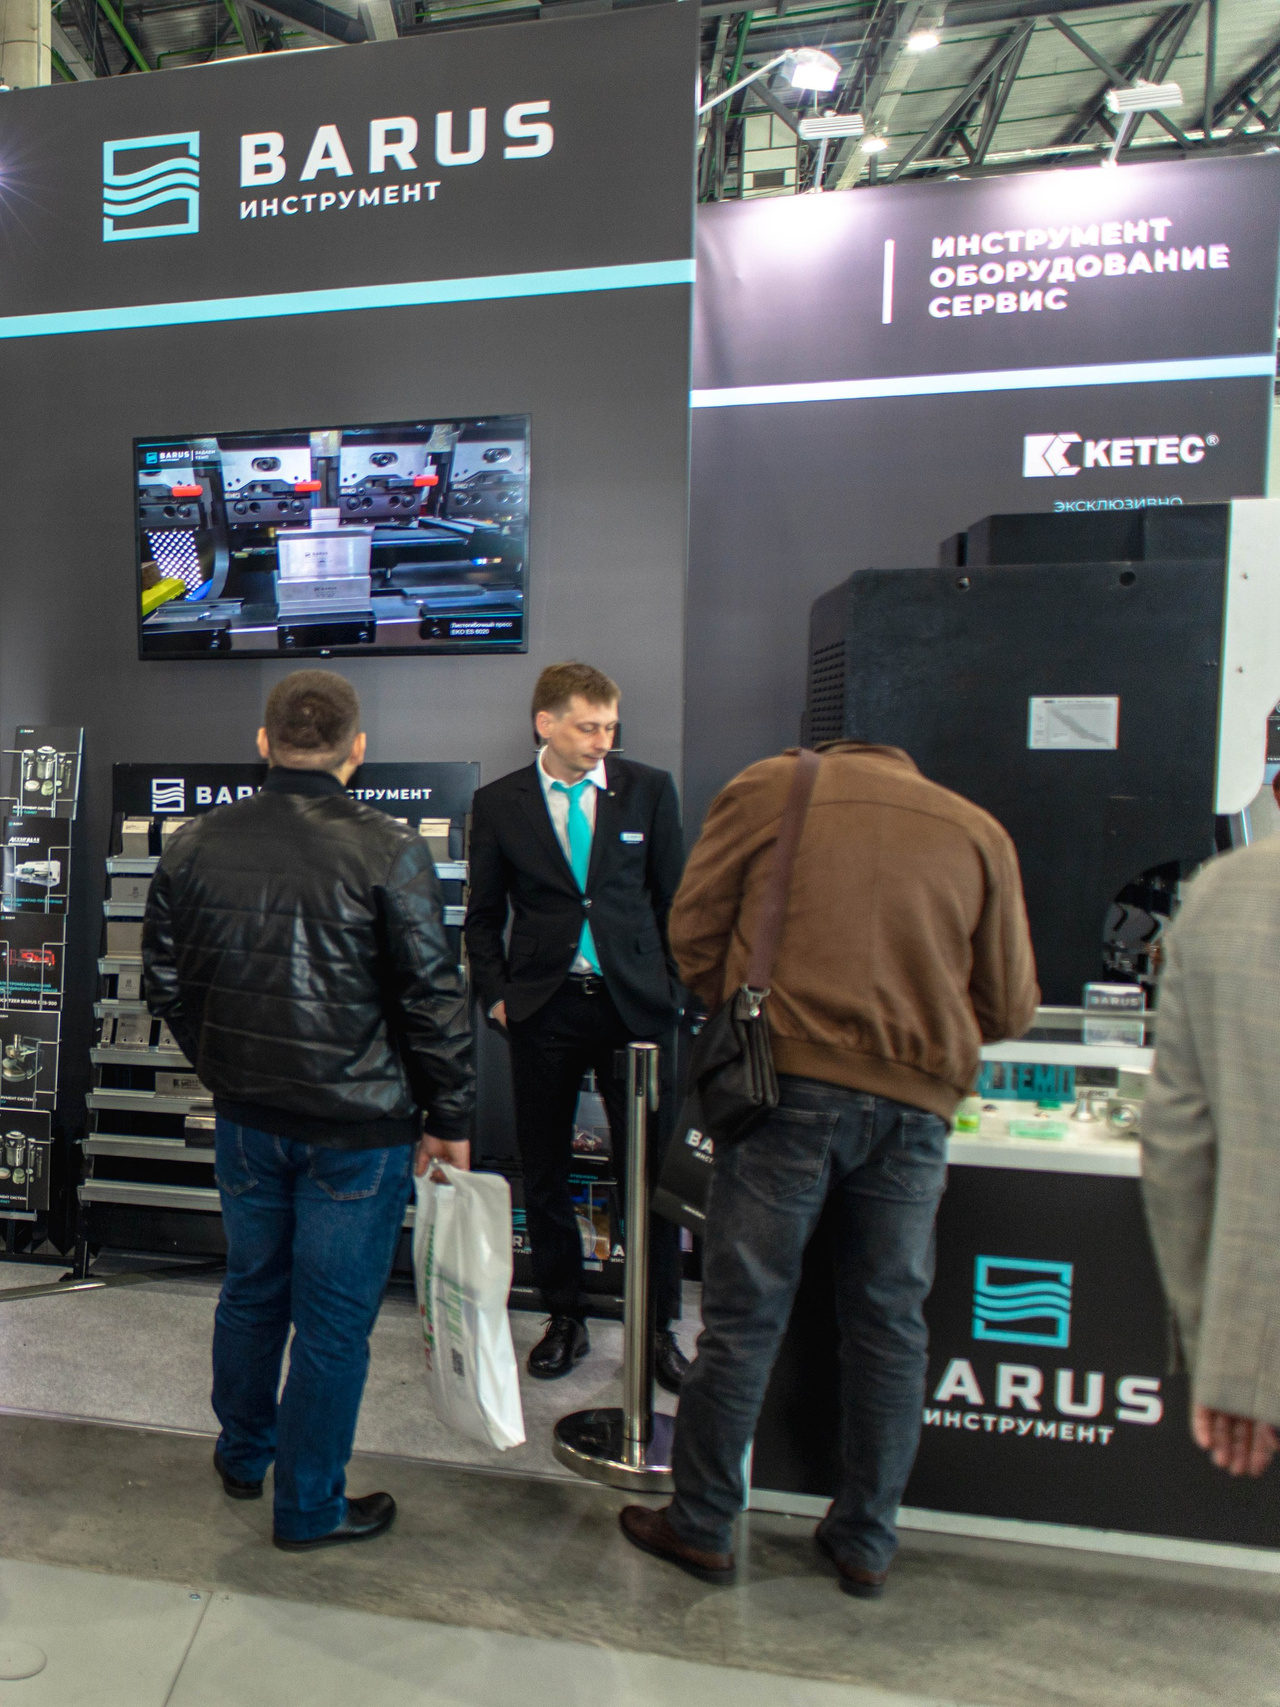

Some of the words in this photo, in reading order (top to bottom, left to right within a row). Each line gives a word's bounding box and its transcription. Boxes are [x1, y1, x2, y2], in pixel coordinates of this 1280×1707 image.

[239, 100, 555, 188] BARUS
[239, 181, 442, 220] ИНСТРУМЕНТ
[931, 217, 1172, 259] ИНСТРУМЕНТ
[928, 243, 1230, 289] ОБОРУДОВАНИЕ
[928, 288, 1068, 319] СЕРВИС
[160, 450, 190, 459] BARUS
[345, 788, 432, 800] СТРУМЕНТ
[933, 1357, 1165, 1425] ARUS
[921, 1408, 1115, 1445] ИНСТРУМЕНТ
